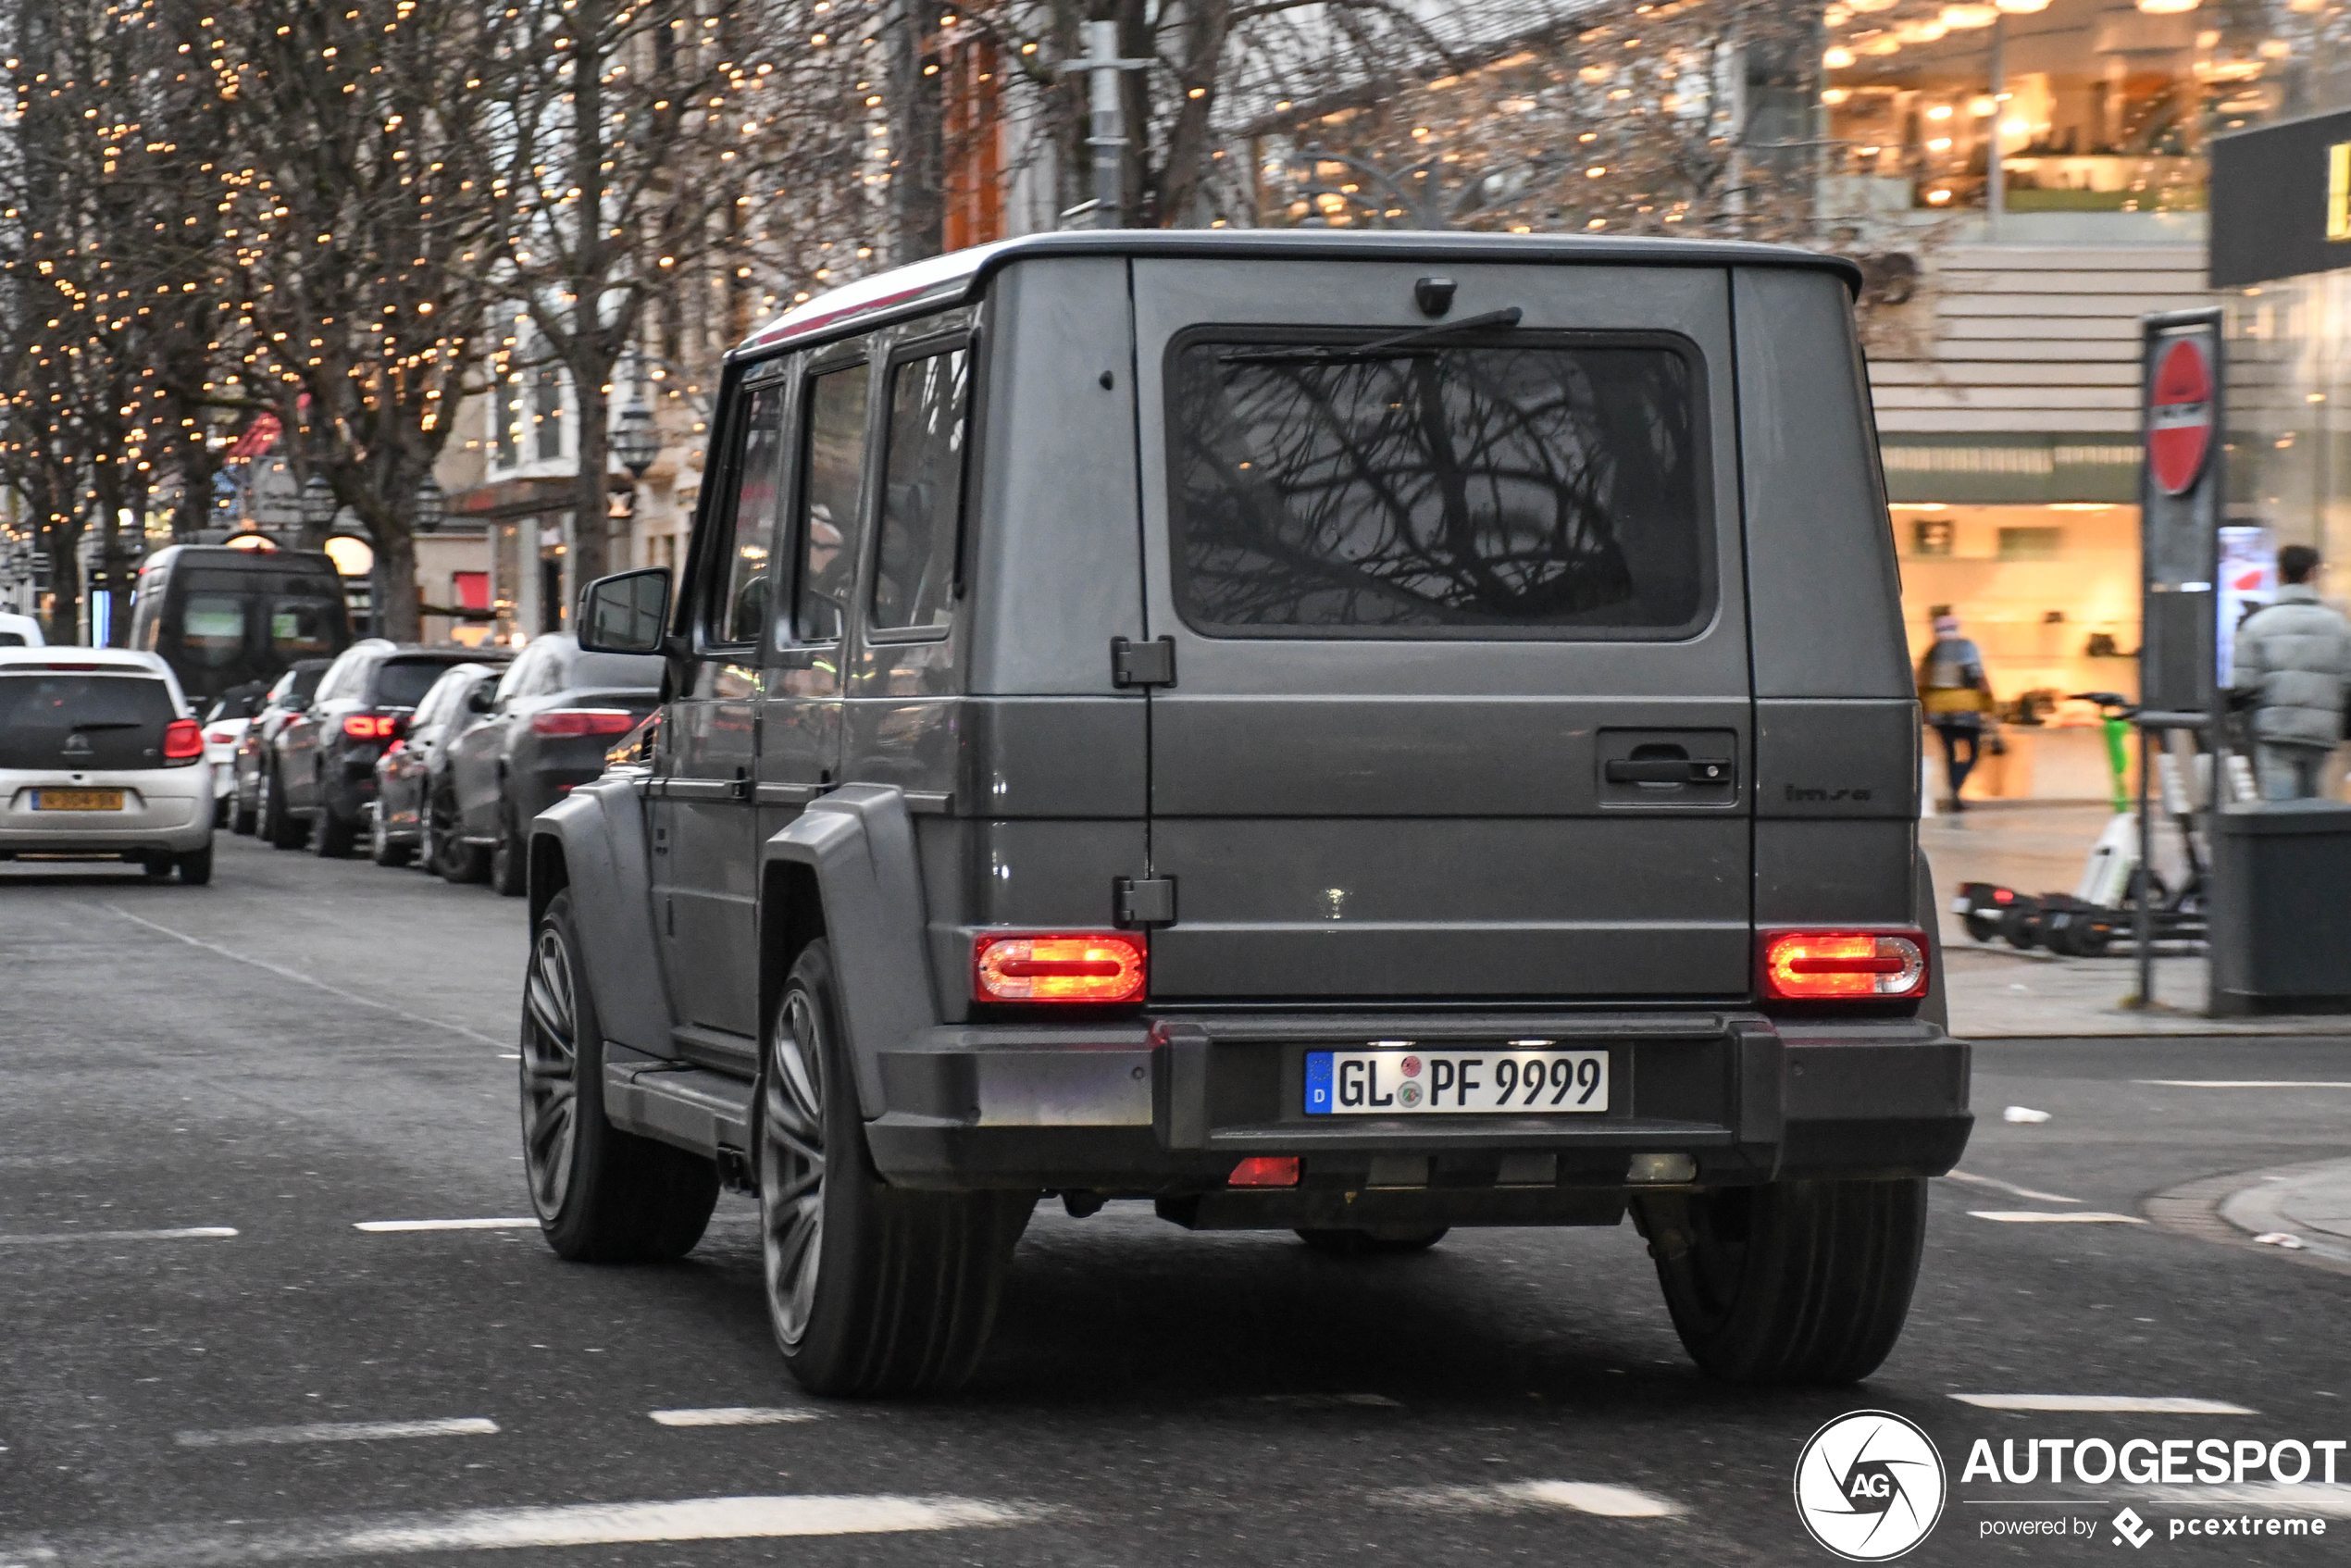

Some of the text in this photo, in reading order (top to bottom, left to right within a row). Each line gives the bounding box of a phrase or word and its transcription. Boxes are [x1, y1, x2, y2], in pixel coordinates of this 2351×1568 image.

[1314, 1089, 1325, 1102] D
[1339, 1058, 1600, 1106] GL PF 9999
